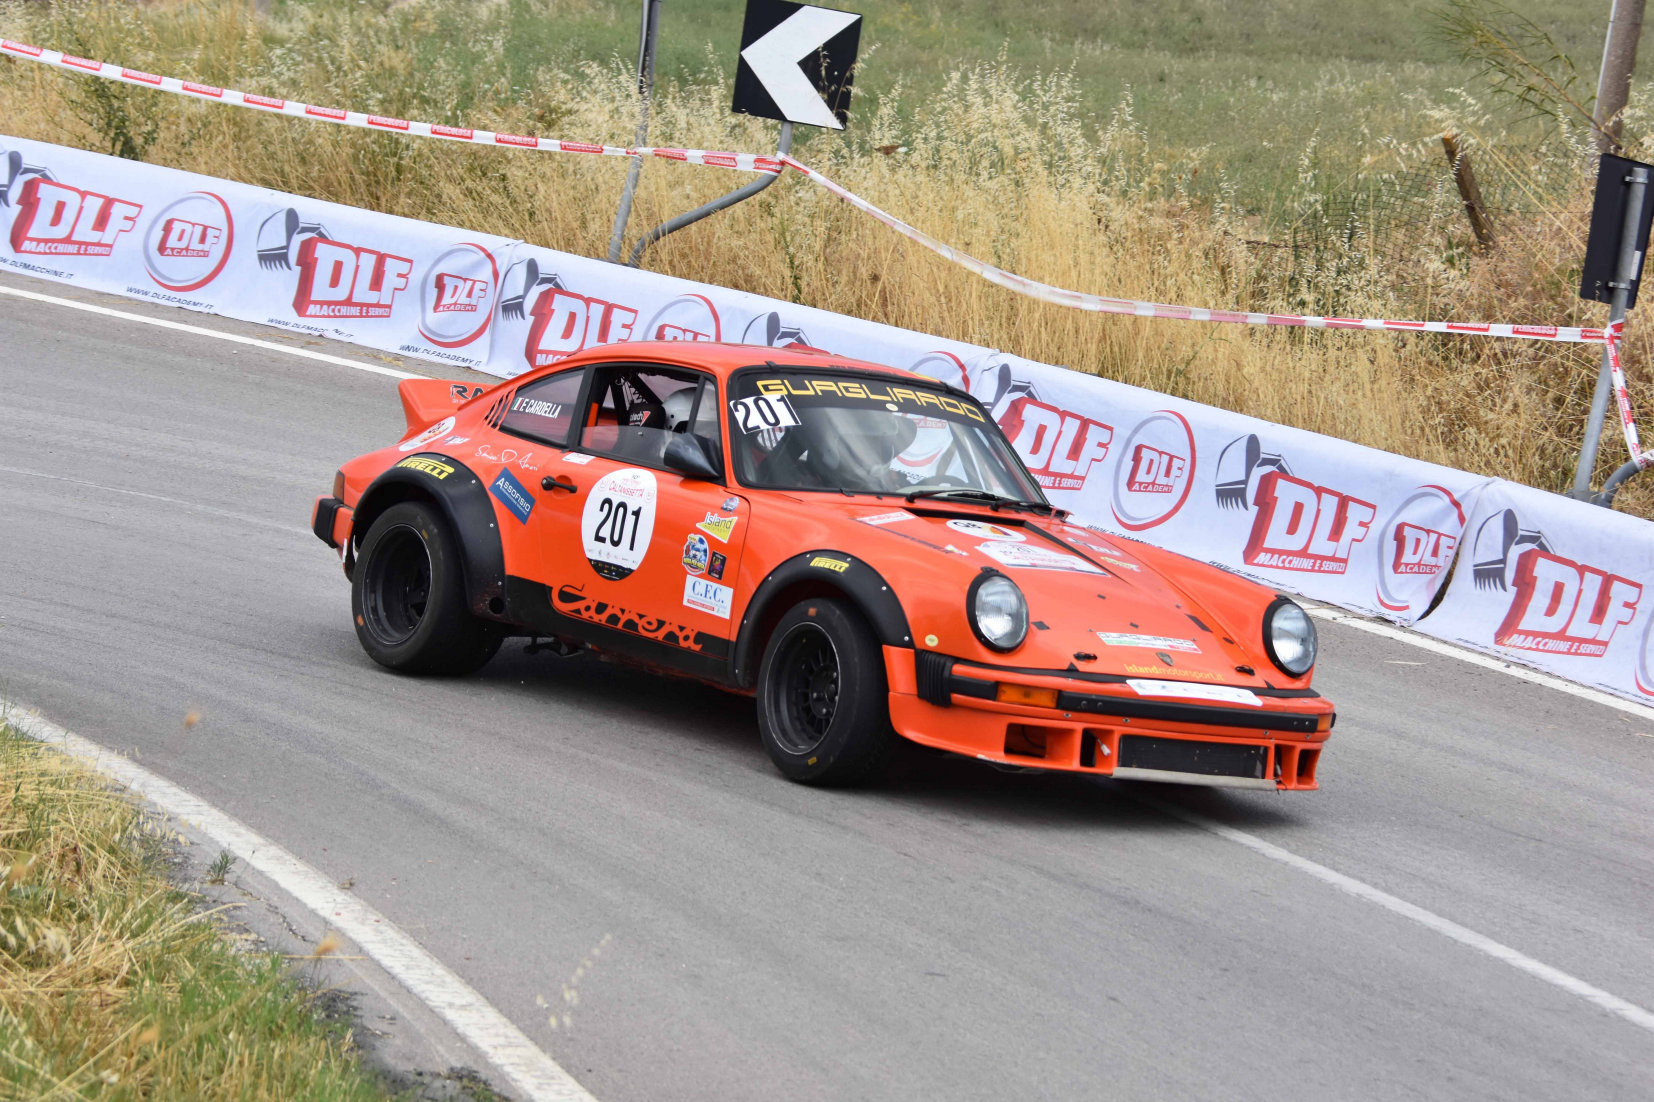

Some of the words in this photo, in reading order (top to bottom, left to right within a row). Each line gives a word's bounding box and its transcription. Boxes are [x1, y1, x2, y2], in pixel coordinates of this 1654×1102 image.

[496, 134, 536, 146] PERICOLOSA
[27, 182, 144, 245] DLF
[20, 240, 78, 254] MACCHINE
[80, 244, 86, 254] E
[87, 245, 112, 255] SERVIZI
[166, 219, 222, 249] DLF
[0, 256, 74, 279] W.DLFMACCHINE.IT
[164, 248, 209, 257] ACADEMY
[311, 241, 414, 305] DLF
[440, 275, 488, 305] DLF
[306, 304, 361, 316] MACCHINE
[362, 306, 367, 316] E
[368, 306, 391, 316] SERVIZI
[538, 294, 638, 352] DLF
[733, 394, 801, 433] 201
[756, 379, 985, 423] GUAGLIARDO
[1013, 403, 1114, 477] DLF
[398, 457, 455, 480] PIRELLI
[1135, 446, 1186, 485] DLF
[1055, 476, 1060, 488] E
[1061, 478, 1083, 489] SERVIZI
[1132, 484, 1172, 493] ACADEMY
[594, 497, 642, 552] 201
[1263, 476, 1377, 559] DLF
[1401, 527, 1456, 566] DLF
[810, 556, 850, 573] PIRELLI
[1253, 552, 1313, 571] MACCHINE
[1315, 560, 1321, 571] E
[1322, 561, 1346, 572] SERVIZI
[692, 580, 724, 604] C.F.C.
[1517, 556, 1643, 642] DLF
[1505, 634, 1569, 652] MACCHINE
[1571, 641, 1578, 653] E
[1579, 643, 1605, 655] SERVIZI
